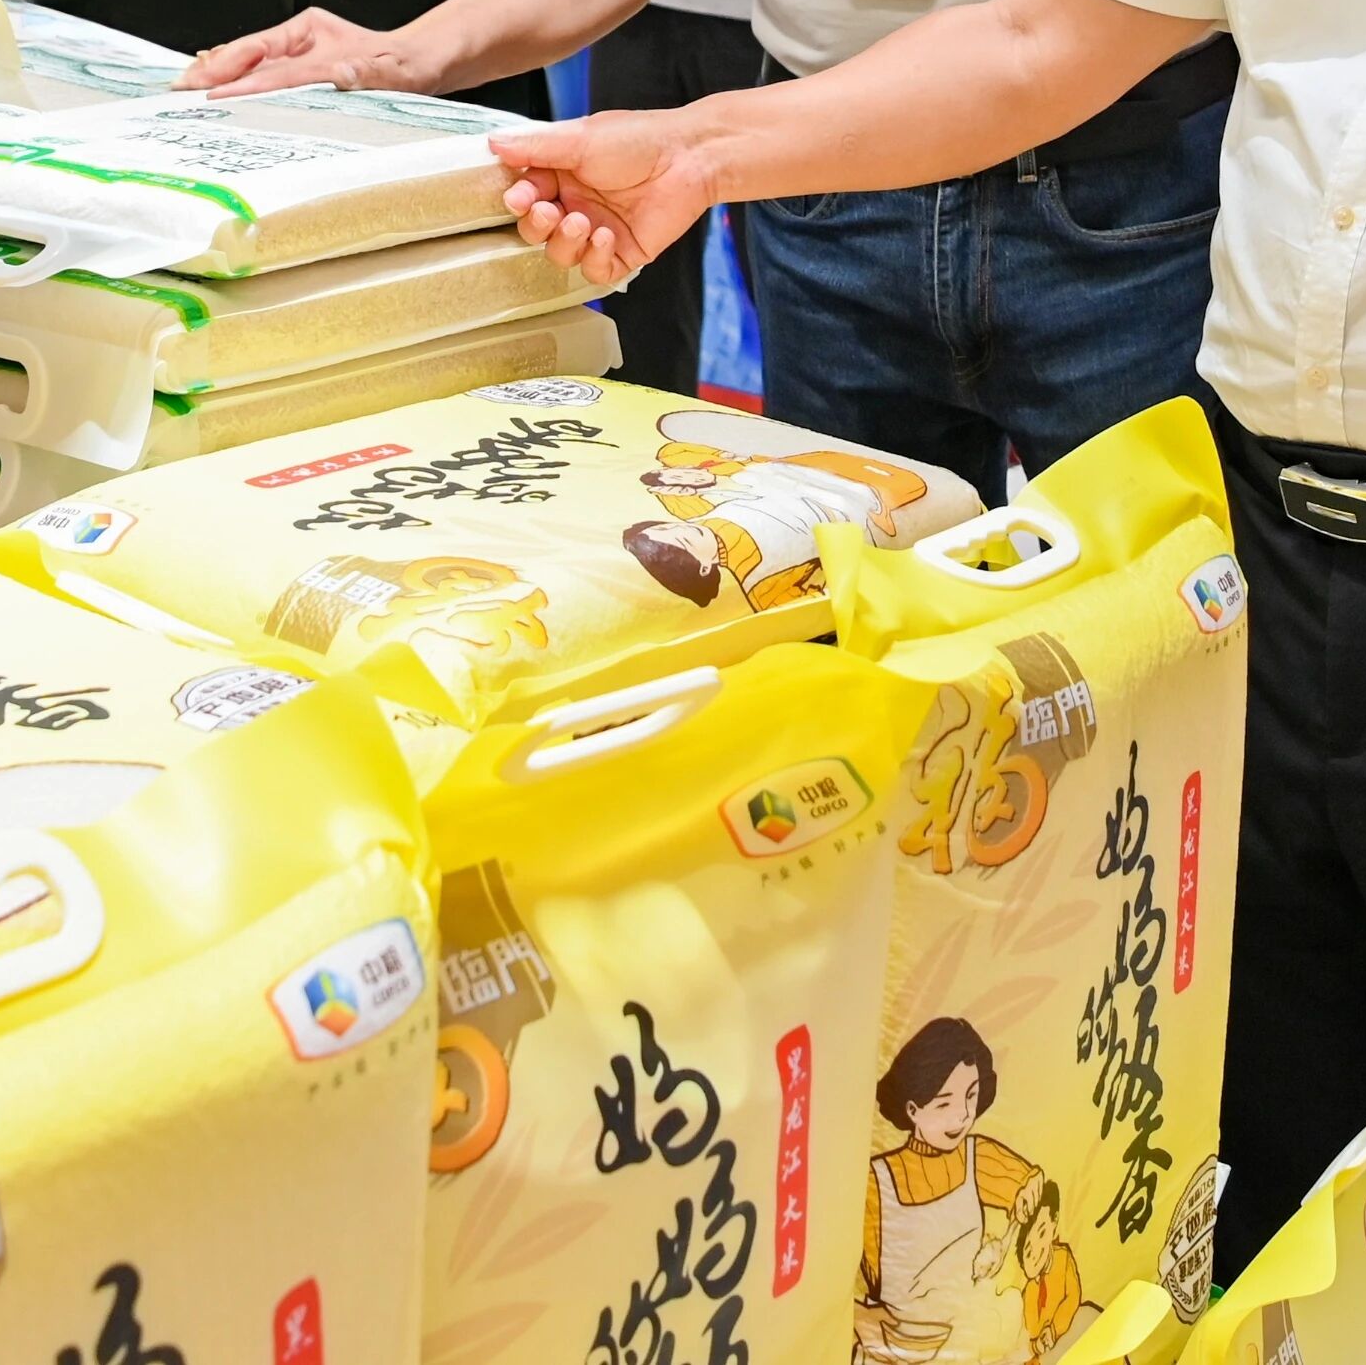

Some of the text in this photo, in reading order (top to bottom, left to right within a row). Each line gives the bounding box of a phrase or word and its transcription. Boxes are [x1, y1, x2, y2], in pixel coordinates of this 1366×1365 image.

[797, 776, 841, 805] 中粮
[809, 797, 849, 820] COFCO
[1179, 786, 1199, 976] 黑龙江大米
[780, 1047, 807, 1277] 黑龙江大米
